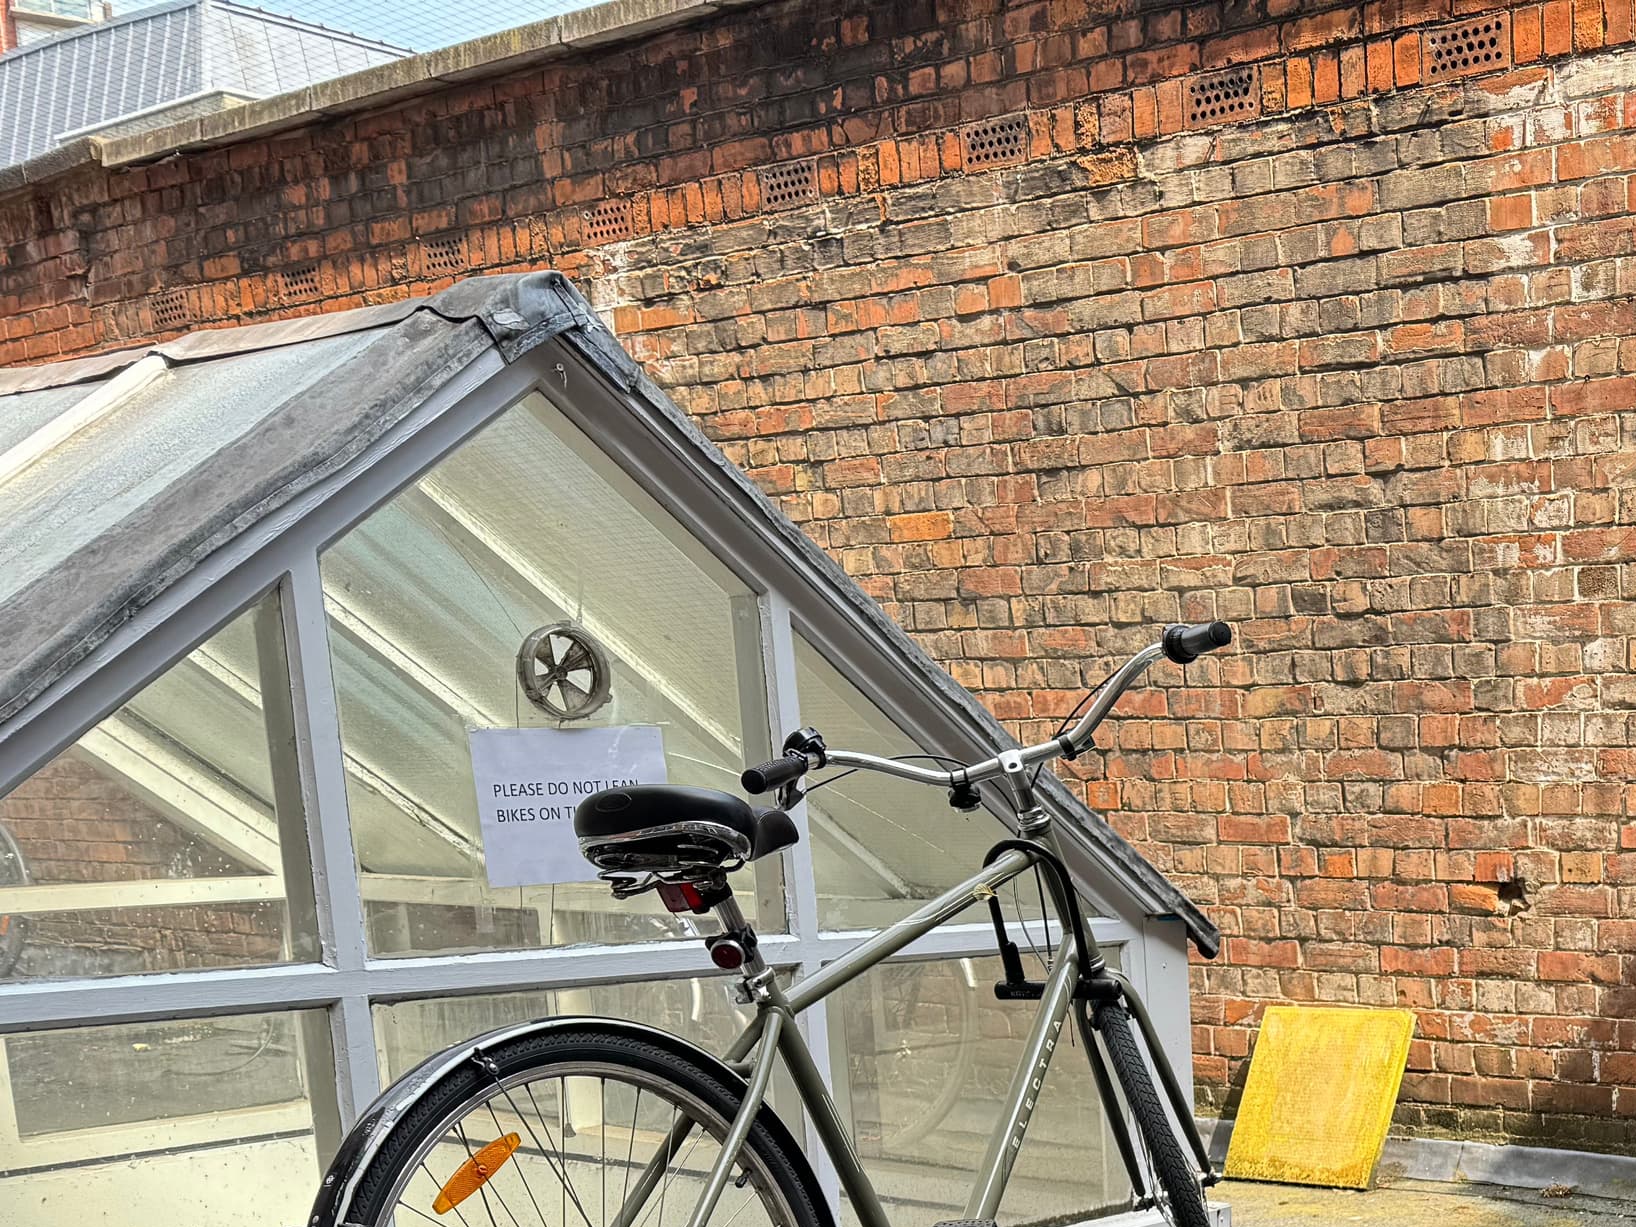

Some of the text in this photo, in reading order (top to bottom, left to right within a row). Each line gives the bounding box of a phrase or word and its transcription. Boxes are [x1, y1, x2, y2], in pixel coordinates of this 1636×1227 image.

[493, 783, 544, 798] PLEASE
[547, 782, 569, 796] DO
[573, 780, 601, 795] NOT
[496, 808, 536, 823] BIKES
[539, 807, 561, 821] ON
[1011, 1020, 1063, 1150] ELECTRA
